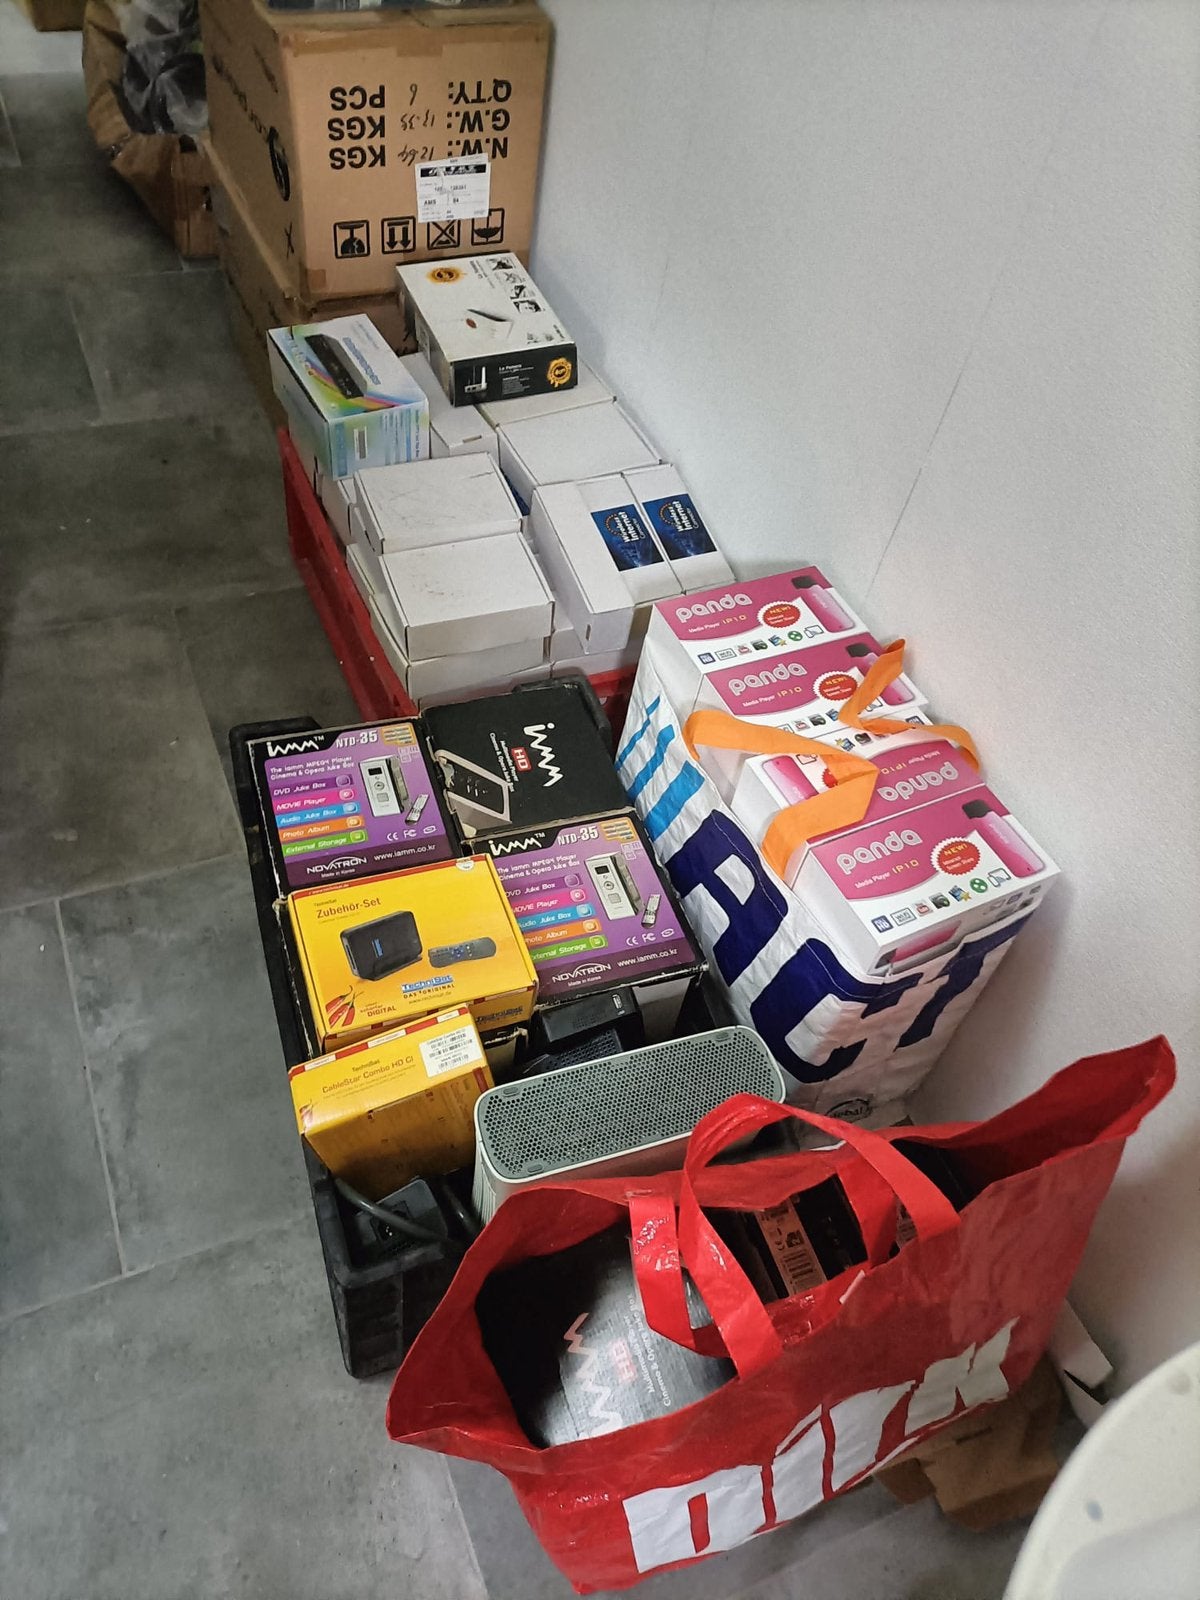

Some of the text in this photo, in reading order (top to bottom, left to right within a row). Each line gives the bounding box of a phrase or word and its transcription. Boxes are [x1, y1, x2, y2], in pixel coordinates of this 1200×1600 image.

[329, 84, 386, 111] PCS
[448, 78, 512, 105] Q'TY:
[327, 114, 386, 141] KGS
[447, 108, 510, 134] G.W.:
[328, 144, 386, 170] KGS
[448, 136, 508, 159] N.W.:
[672, 501, 693, 530] Internet
[618, 511, 639, 542] Internet
[675, 593, 753, 624] panda
[728, 663, 808, 696] panda
[335, 730, 379, 748] NTD-35
[513, 748, 529, 769] HD
[270, 771, 297, 780] Cinema
[304, 767, 325, 776] Opera
[876, 761, 959, 801] panda
[273, 787, 291, 796] DVD
[293, 785, 310, 793] Juke
[276, 797, 327, 811] MOVIE Player
[280, 816, 301, 824] Audio
[282, 825, 330, 839] Photo Album
[557, 825, 599, 846] NTD-35
[285, 837, 347, 854] External Storage
[373, 844, 436, 861] www.iamm.co.kr
[836, 829, 923, 875] panda
[943, 843, 968, 856] NEW!
[306, 857, 367, 874] NOVATRON
[531, 866, 552, 875] Opera
[524, 886, 540, 894] Juke
[542, 882, 555, 890] Box
[536, 899, 559, 908] Player
[540, 916, 555, 924] Juke
[546, 929, 568, 939] Album
[558, 943, 587, 954] Storage
[617, 948, 678, 967] www.iamm.co.kr
[552, 963, 612, 983] NOVATRON
[367, 1005, 396, 1017] DIGITAL
[322, 1075, 362, 1093] CableStar
[362, 1064, 390, 1079] Combo
[391, 1059, 404, 1069] HD
[655, 1371, 671, 1407] Cinema
